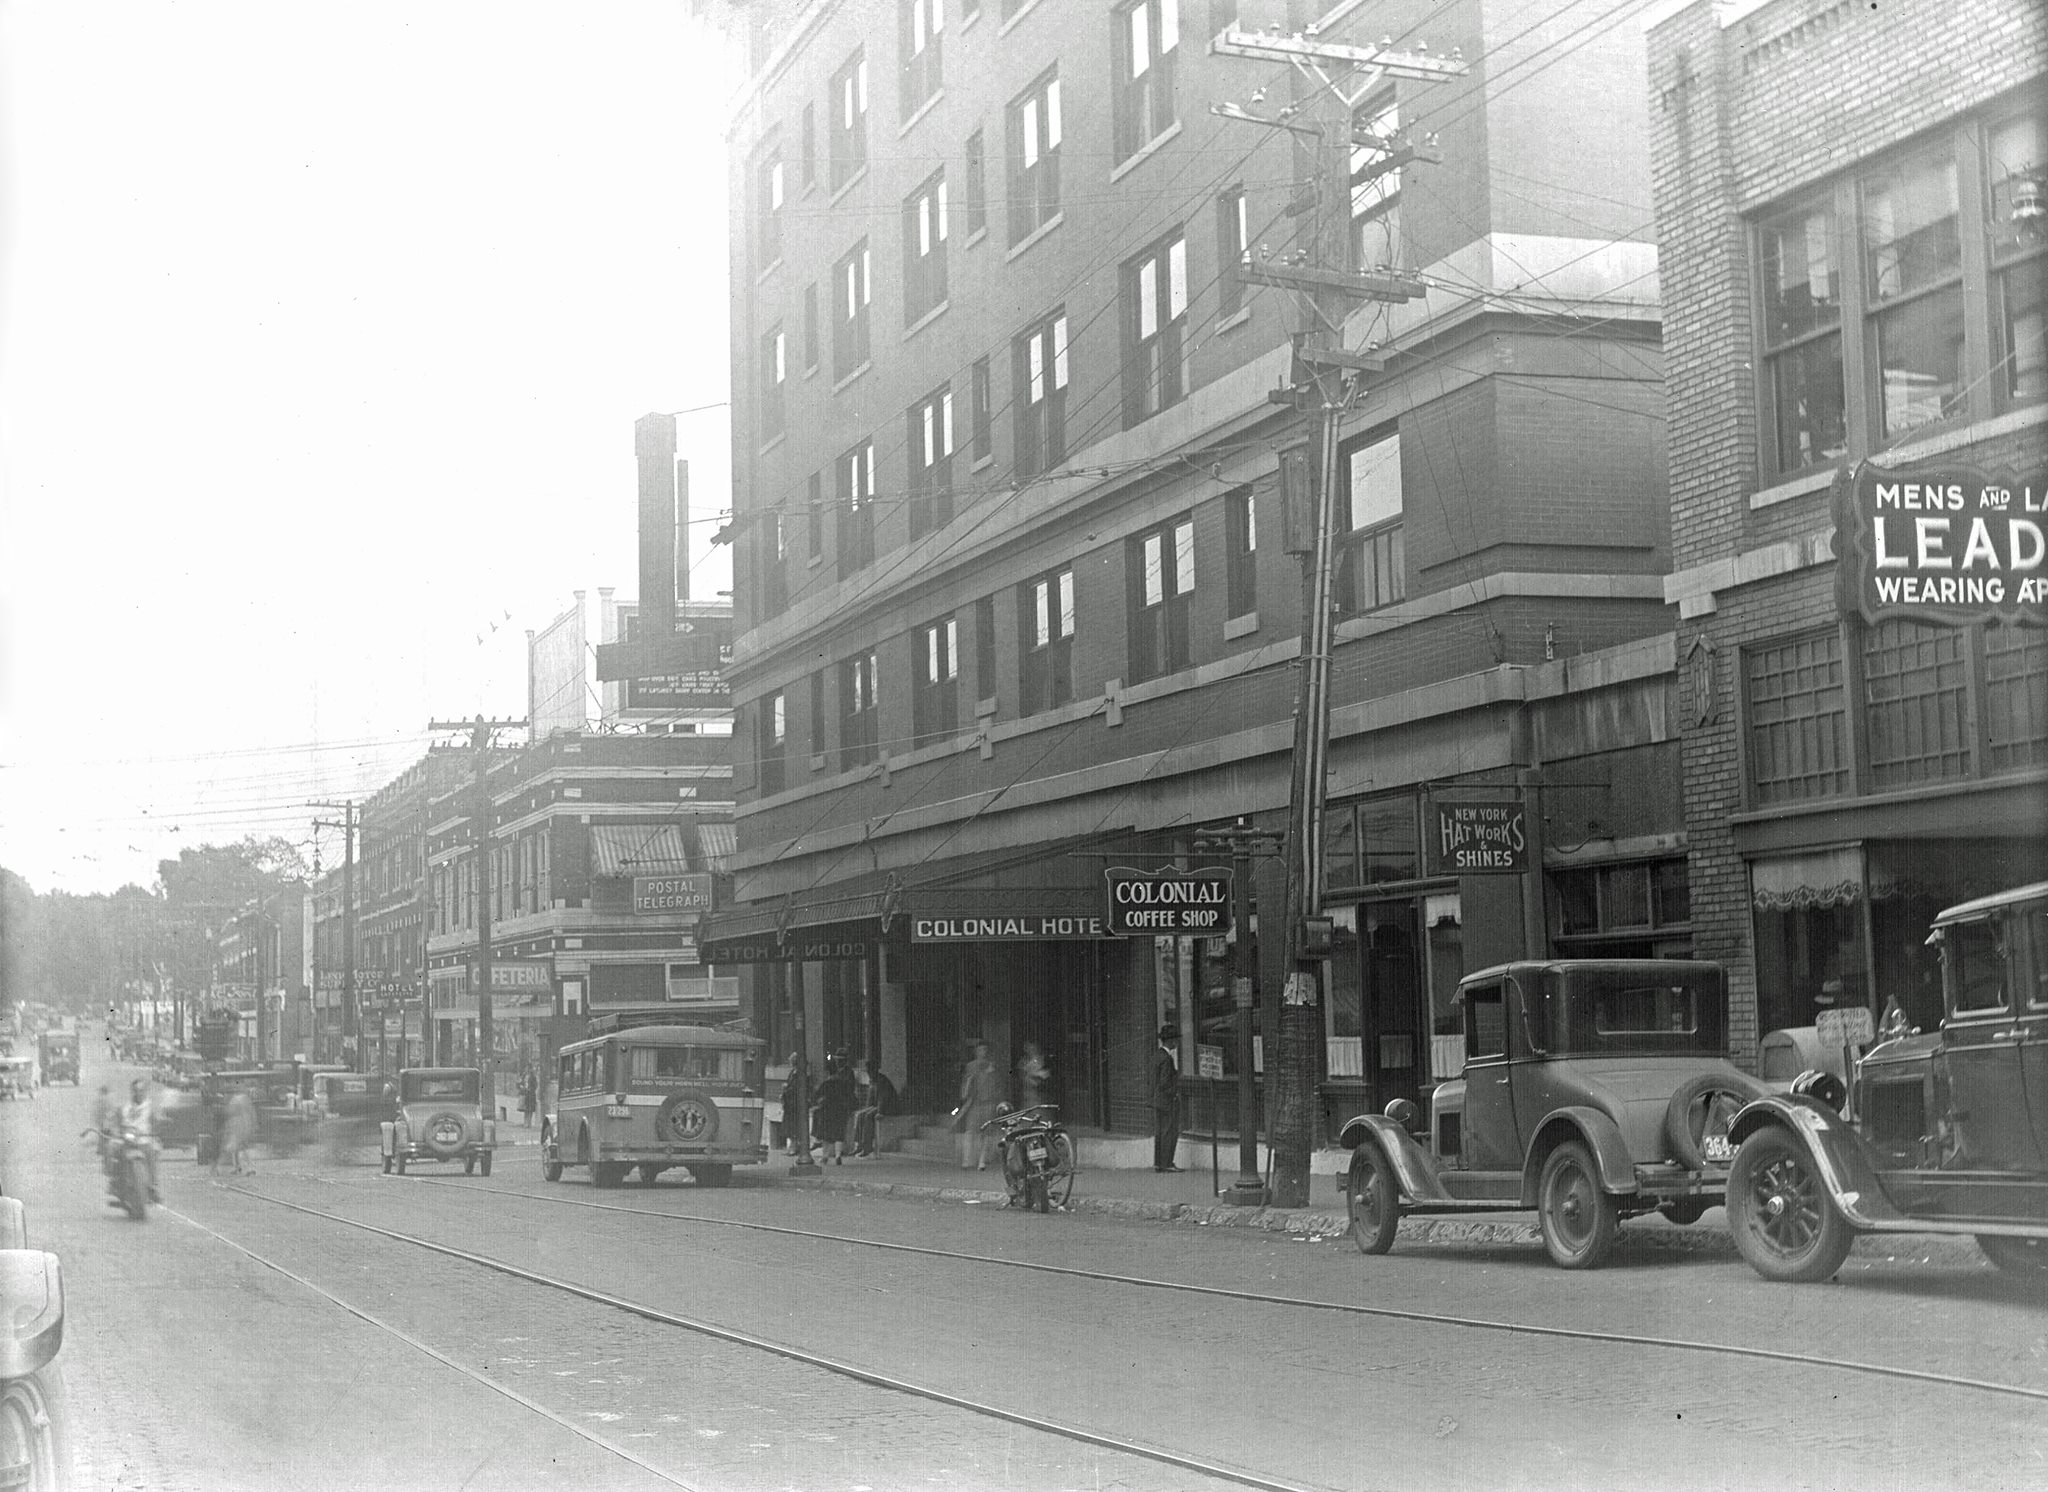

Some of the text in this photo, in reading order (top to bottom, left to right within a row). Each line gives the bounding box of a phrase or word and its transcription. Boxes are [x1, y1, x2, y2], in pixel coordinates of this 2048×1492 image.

[1876, 483, 2048, 512] MENS AND L
[1873, 516, 2046, 571] LEAD
[1874, 576, 2006, 604] WEARING
[1455, 808, 1508, 821] NEW YORK
[1440, 811, 1472, 857] HAT
[1480, 840, 1488, 850] &
[1456, 849, 1514, 867] SHINES
[647, 880, 696, 894] POSTAL
[1116, 881, 1226, 904] COLONIAL
[636, 894, 708, 909] TELEGRAPH
[916, 917, 1103, 938] COLONIAL HOTE
[1125, 910, 1218, 927] COFFEE SHOP
[471, 966, 549, 986] CFETERIA
[380, 983, 414, 992] HOTEL
